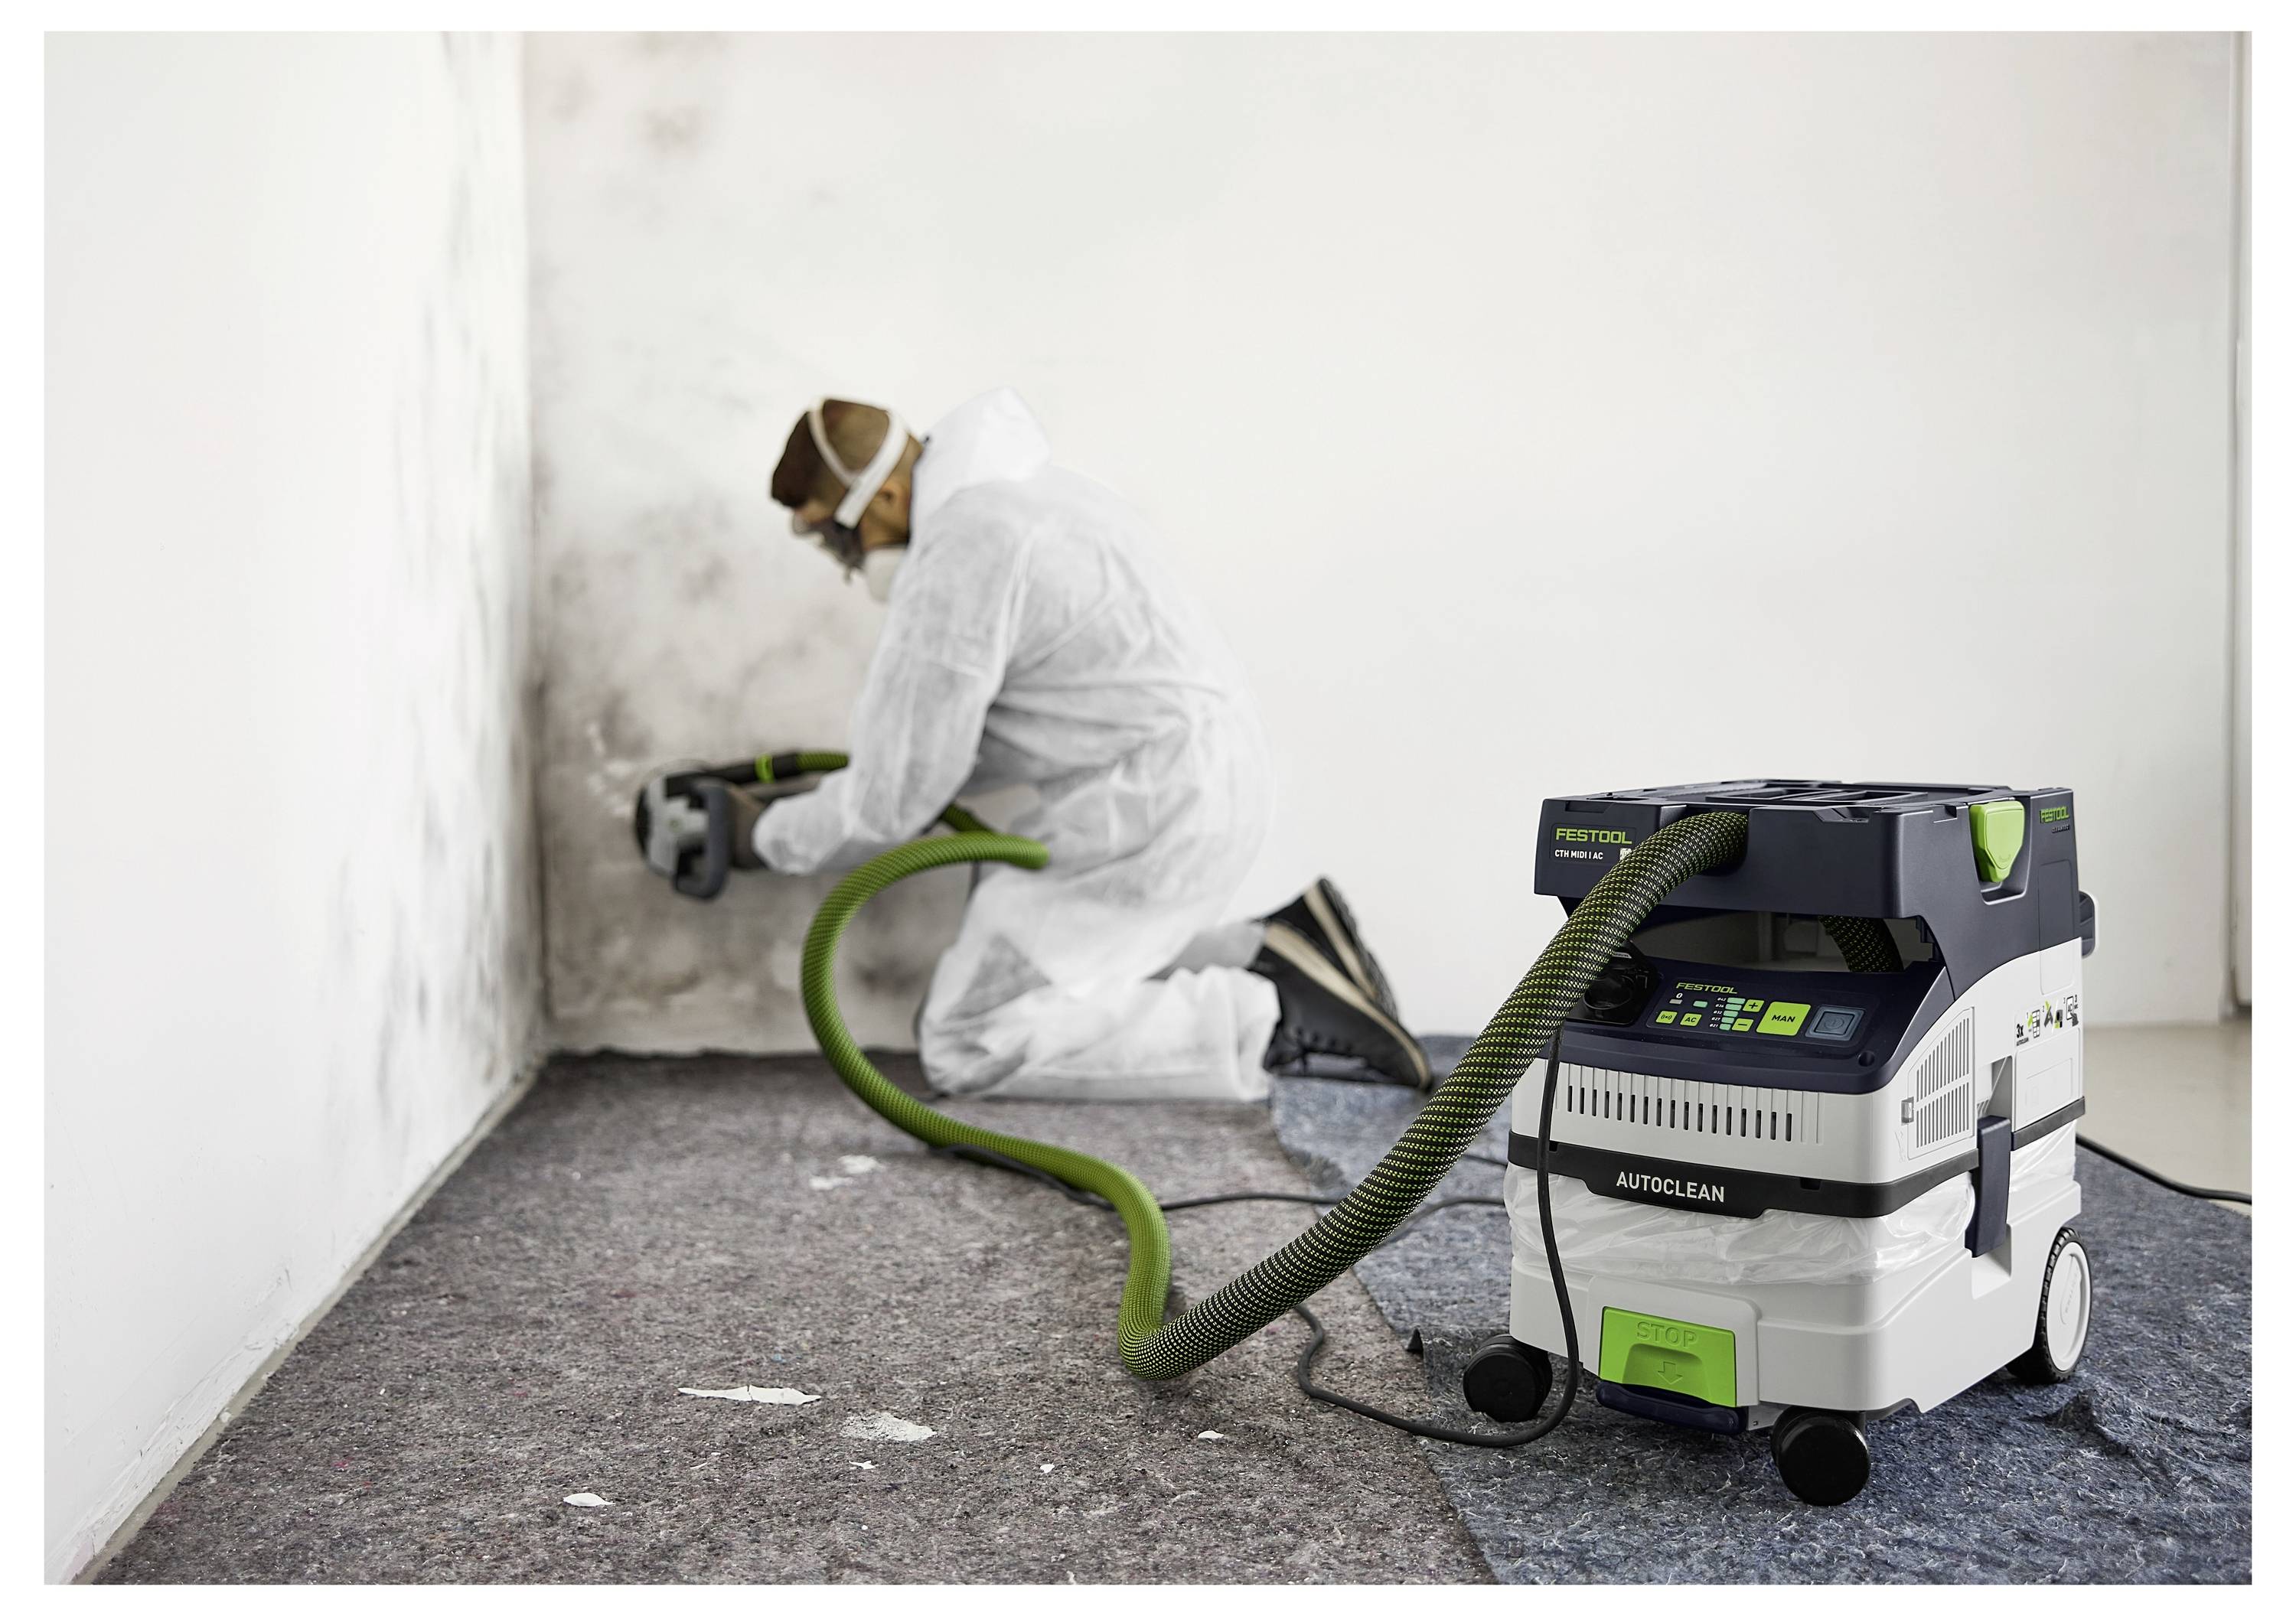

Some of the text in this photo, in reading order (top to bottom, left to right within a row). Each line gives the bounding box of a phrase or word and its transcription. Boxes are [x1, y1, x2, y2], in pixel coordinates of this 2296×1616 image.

[2040, 807, 2069, 823] FESTOOL
[1555, 828, 1632, 845] FESTOOL
[1554, 849, 1570, 858] CTH
[1570, 850, 1587, 858] MIDI
[1592, 852, 1603, 860] AC
[1676, 982, 1737, 994] FESTOOL
[1771, 1015, 1795, 1023] MAN
[2017, 1024, 2024, 1038] 3x
[1616, 1171, 1725, 1203] AUTOCLEAN
[1636, 1321, 1698, 1349] STOP
